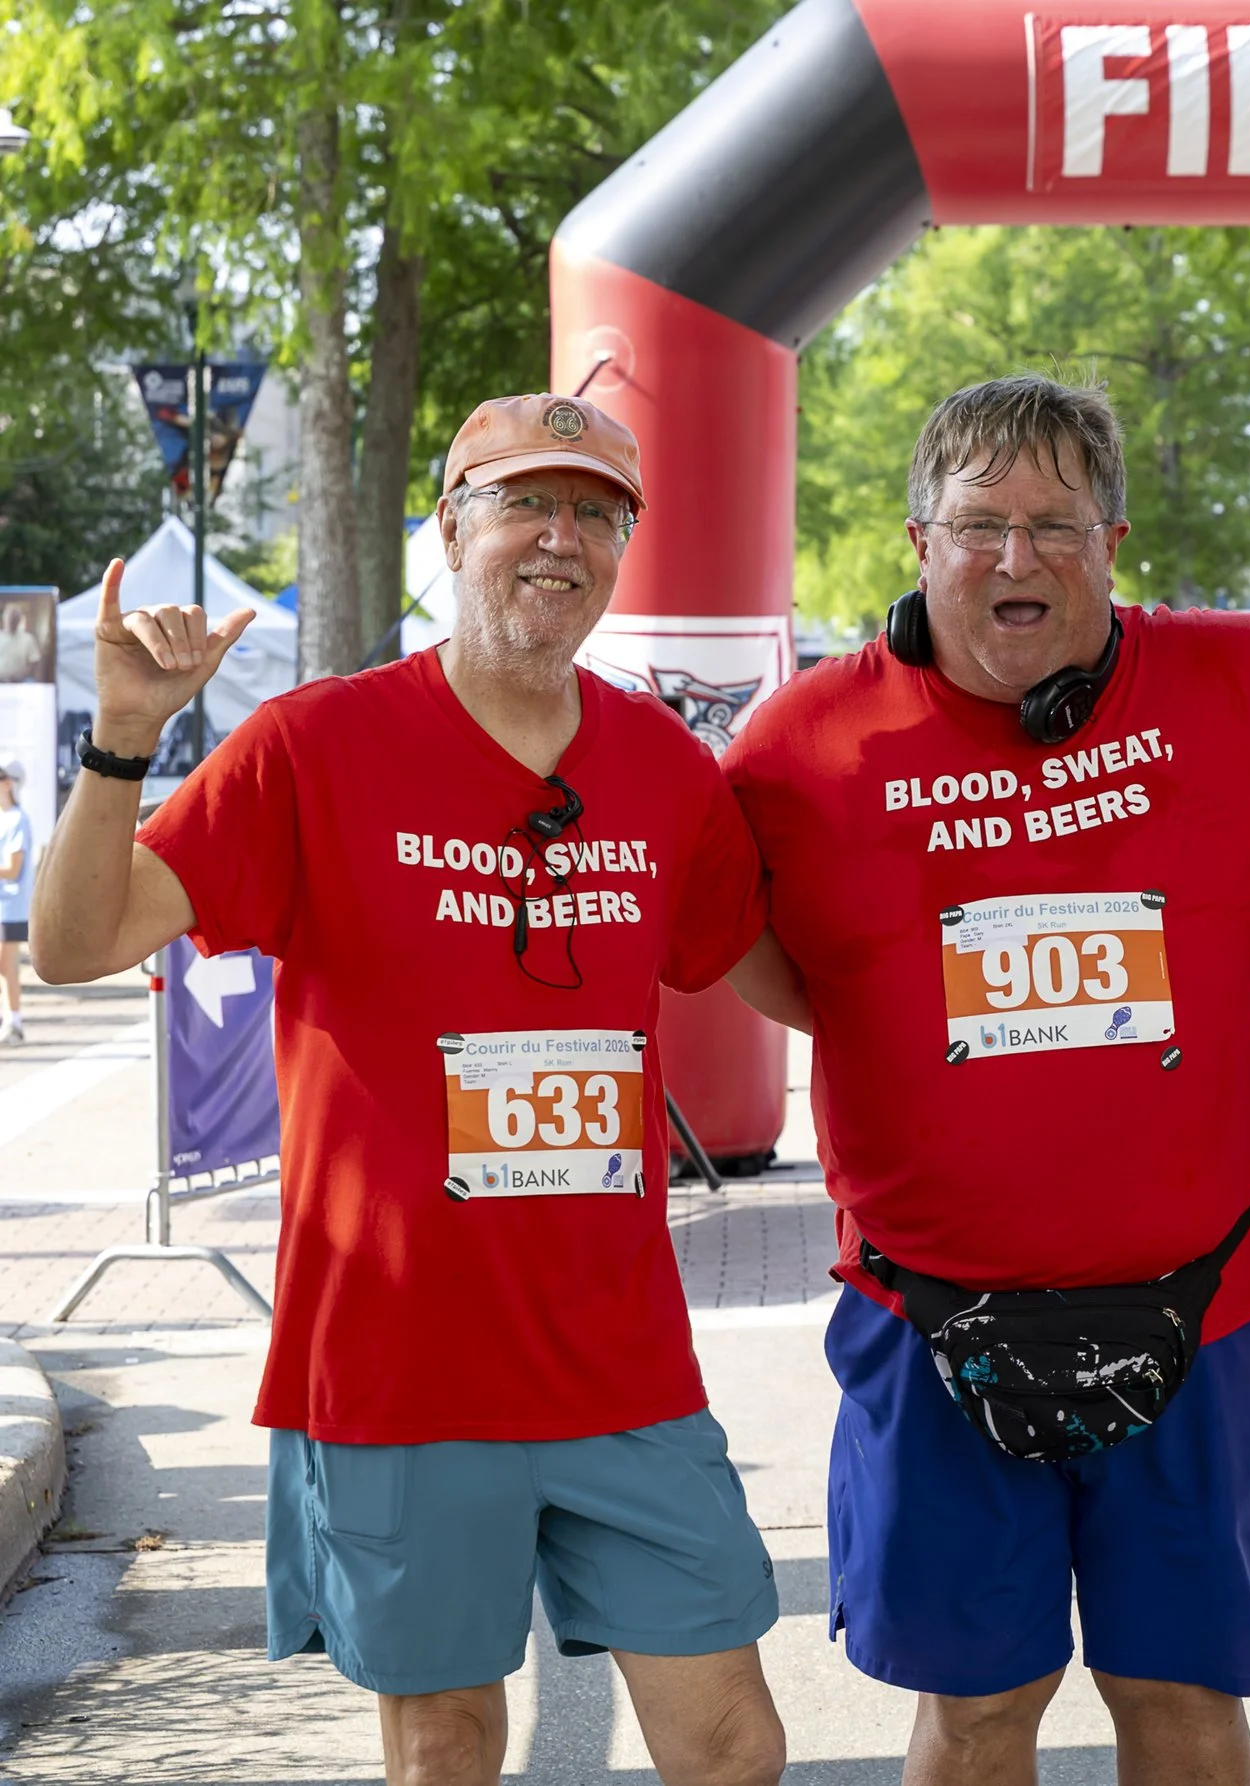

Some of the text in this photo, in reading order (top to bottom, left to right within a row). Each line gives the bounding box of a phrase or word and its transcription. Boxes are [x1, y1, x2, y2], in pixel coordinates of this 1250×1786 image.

[553, 415, 580, 432] 66
[885, 728, 1174, 812] BLOOD, SWEAT,
[927, 783, 1150, 852] AND BEERS
[397, 831, 657, 885] BLOOD, SWEAT,
[435, 889, 641, 929] AND BEERS
[962, 901, 1140, 924] Courir du Festival 2026
[1050, 921, 1067, 929] Run
[982, 933, 1128, 1009] 903
[466, 1039, 516, 1055] Courir
[522, 1038, 541, 1053] du
[546, 1039, 601, 1053] Festival
[605, 1039, 630, 1053] 2026
[544, 1059, 572, 1067] 5K Run
[488, 1074, 621, 1148] 633
